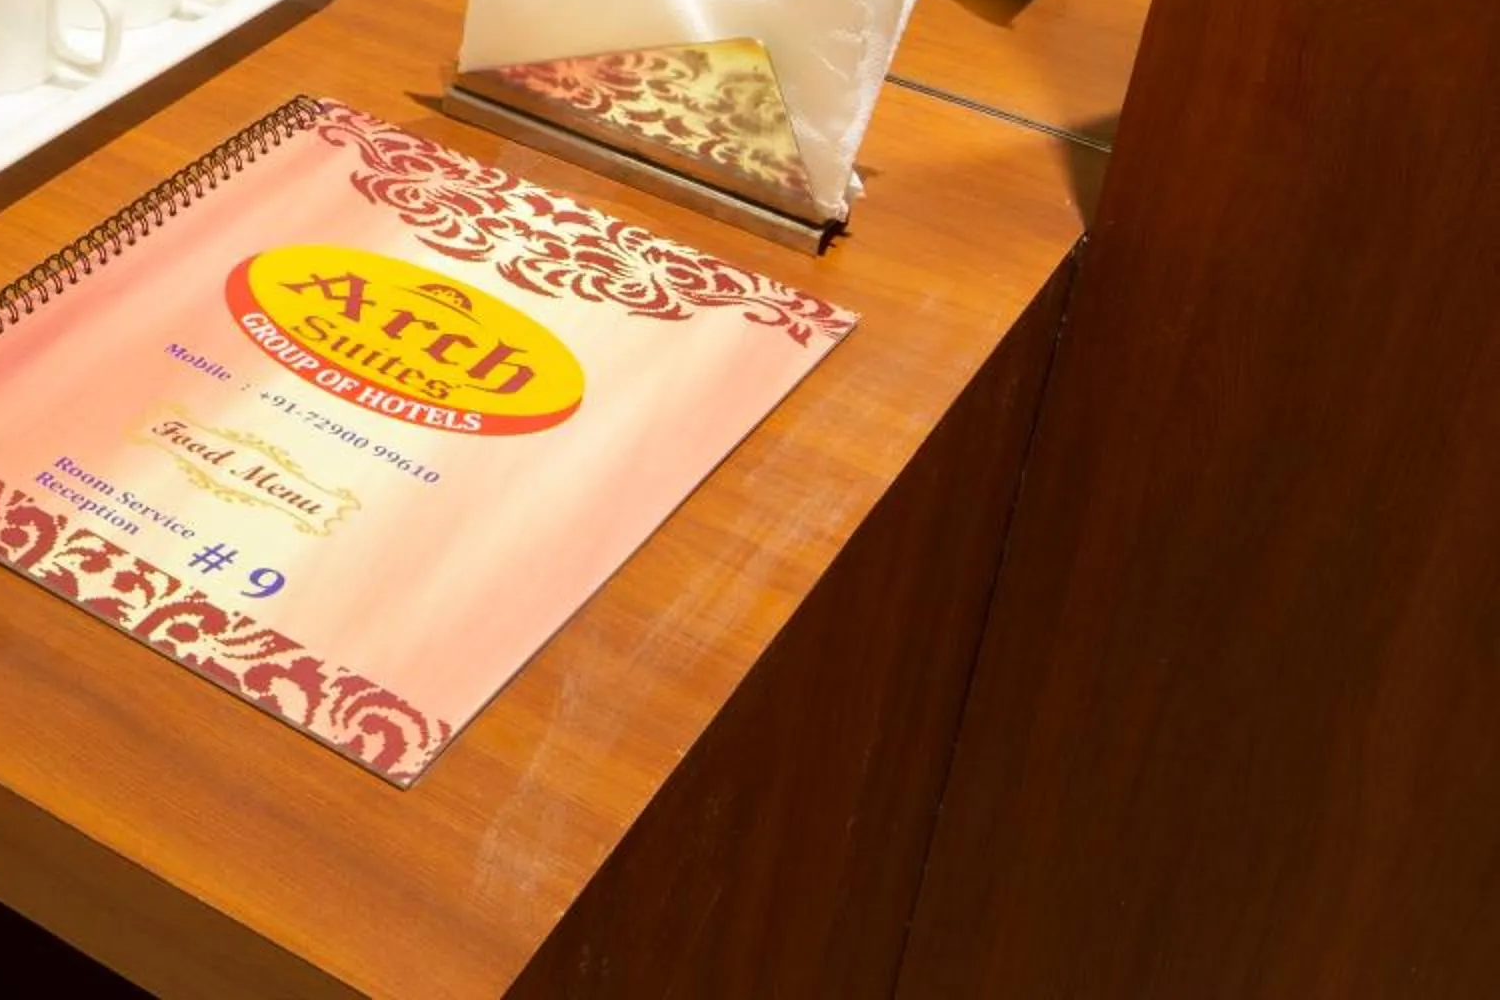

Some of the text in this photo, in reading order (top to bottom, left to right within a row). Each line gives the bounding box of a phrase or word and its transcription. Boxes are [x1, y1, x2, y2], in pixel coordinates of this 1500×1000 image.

[241, 312, 483, 431] GROUP OF HOTELS
[279, 271, 536, 395] Arch
[289, 314, 452, 400] Suites
[164, 343, 232, 382] Mobile
[259, 390, 369, 450] +91-72900
[372, 444, 441, 485] 99610
[36, 471, 141, 537] Reception
[54, 455, 195, 540] Room Service
[151, 420, 323, 515] Food Menu
[240, 567, 286, 600] 9
